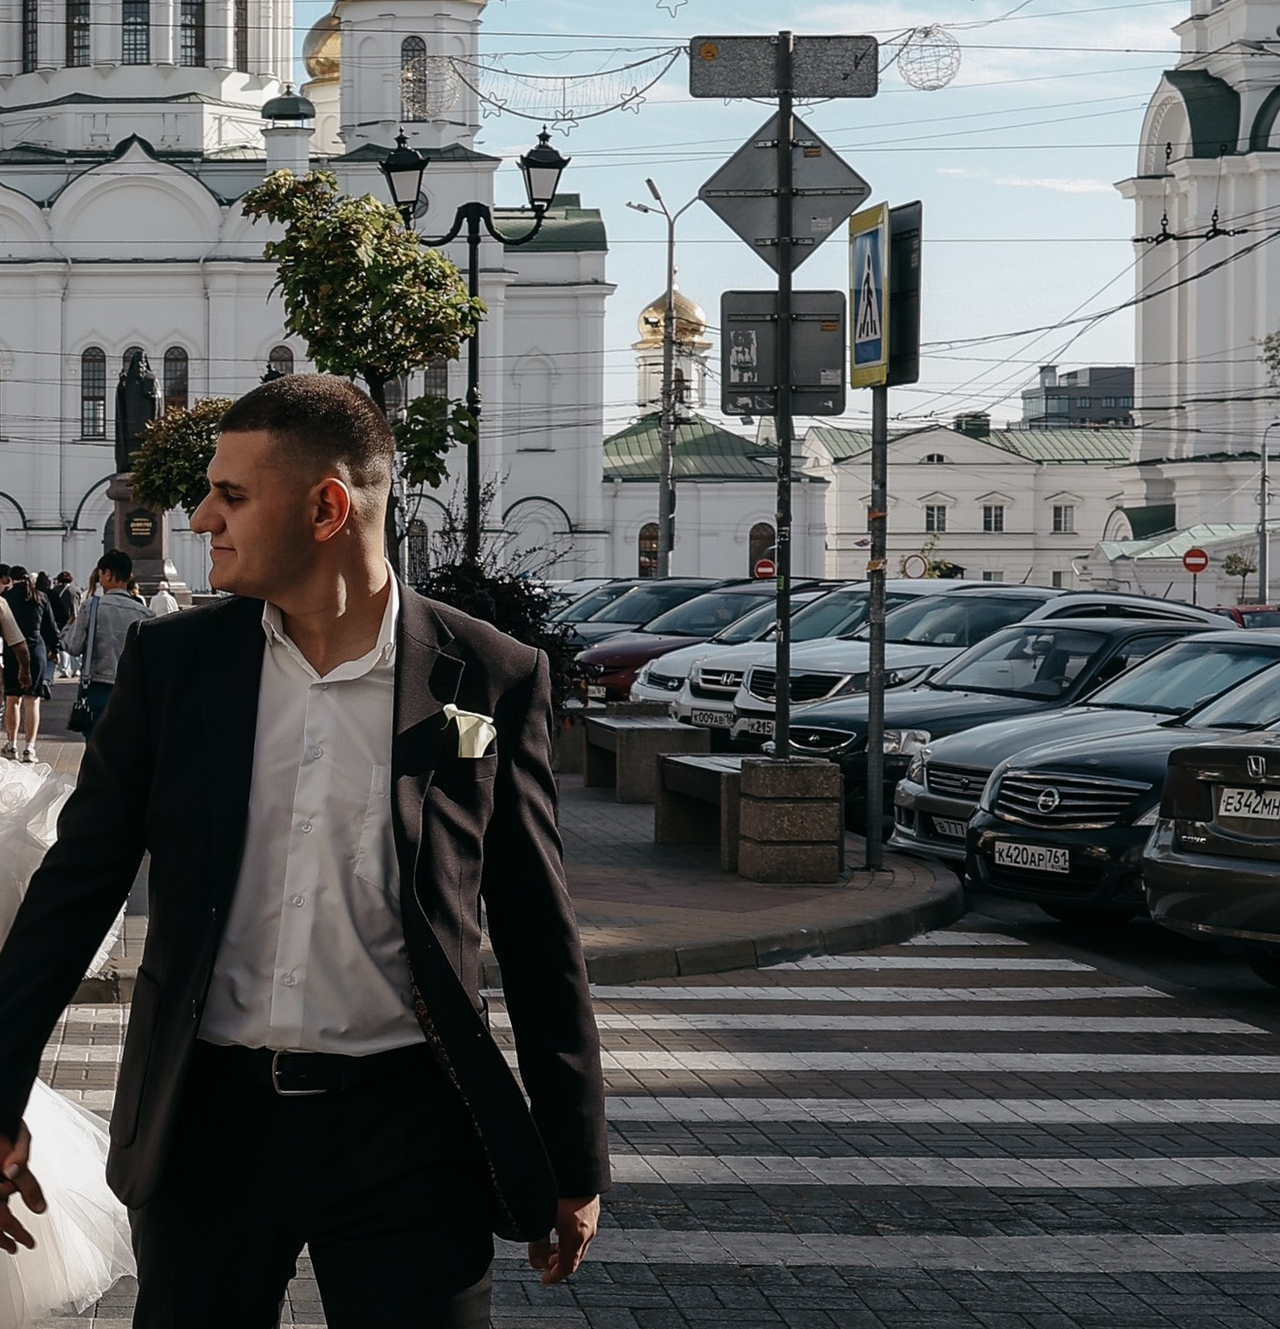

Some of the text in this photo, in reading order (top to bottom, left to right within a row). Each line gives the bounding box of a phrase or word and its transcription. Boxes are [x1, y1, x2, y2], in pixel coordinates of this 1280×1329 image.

[693, 711, 724, 725] К009АВ
[750, 720, 773, 734] К215
[1224, 791, 1280, 816] Е342МН
[940, 820, 965, 836] В777
[998, 845, 1045, 867] К420АР
